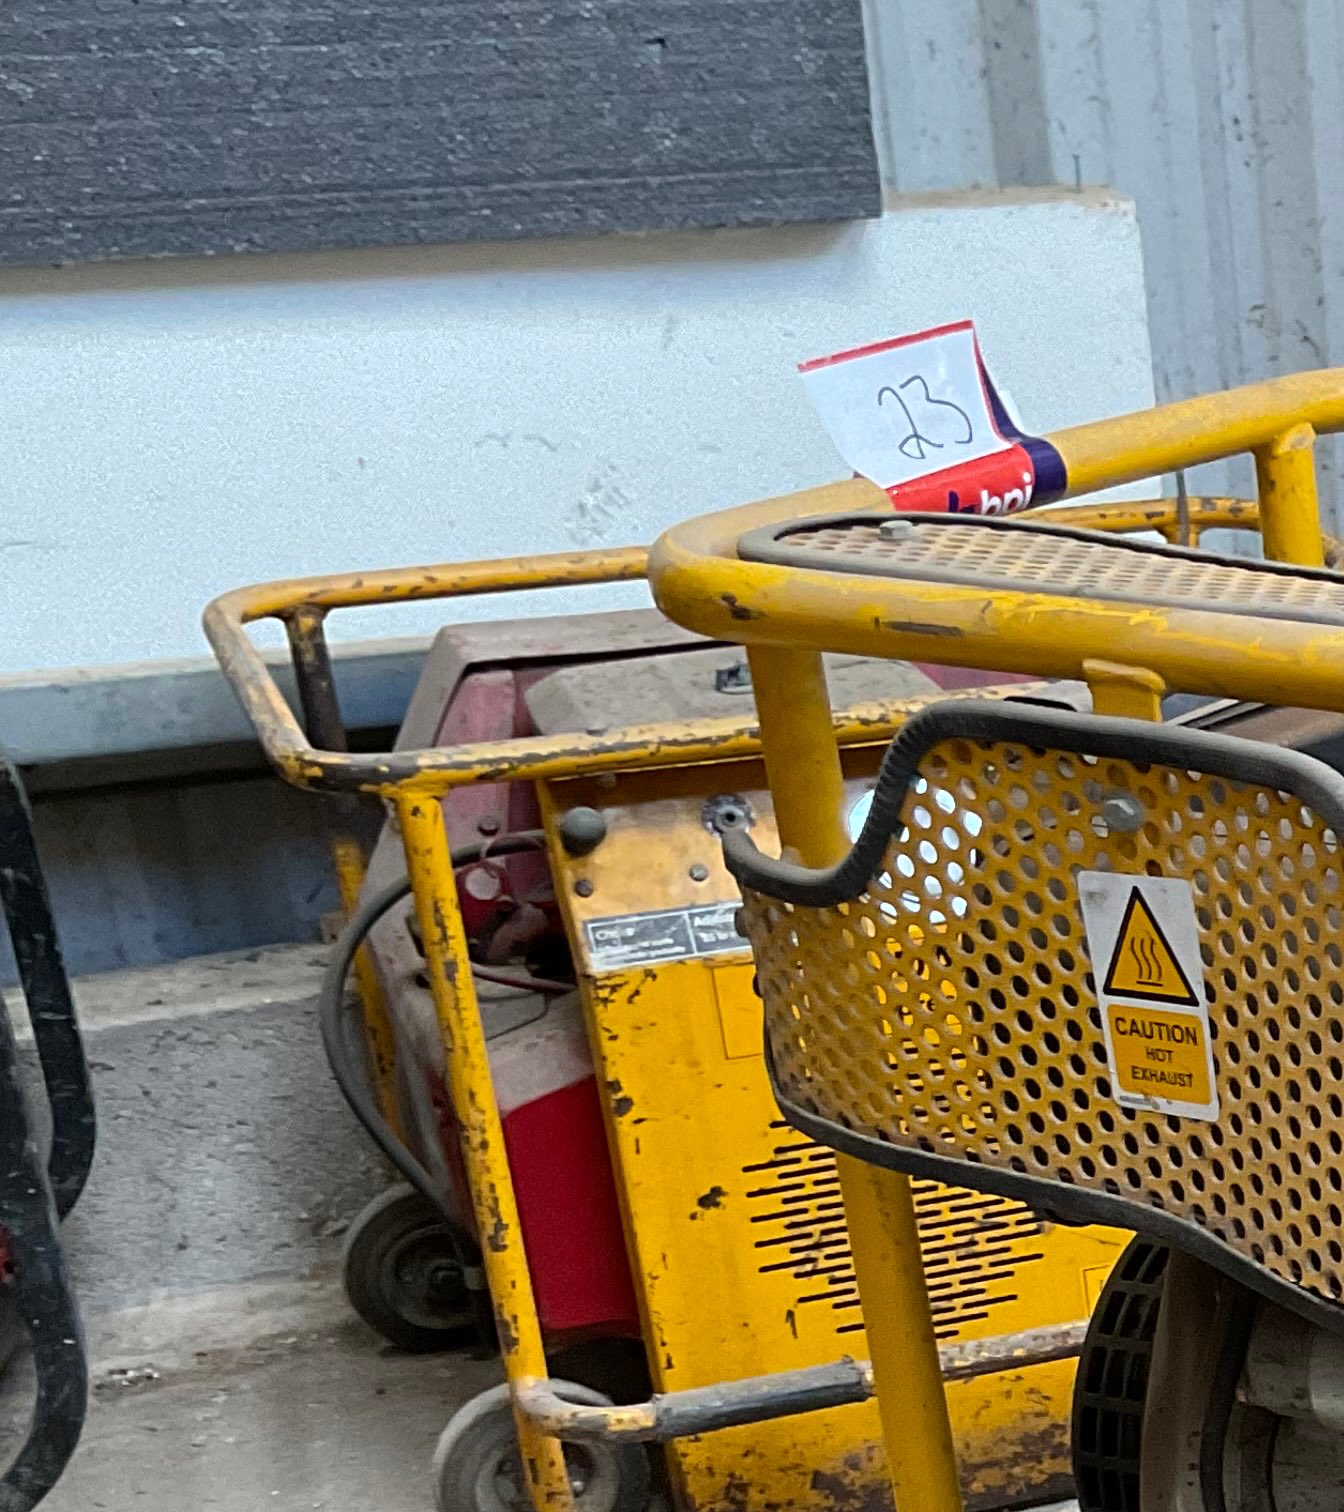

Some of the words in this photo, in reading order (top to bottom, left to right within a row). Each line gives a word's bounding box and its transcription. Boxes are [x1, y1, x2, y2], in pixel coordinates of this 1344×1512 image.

[878, 375, 973, 459] 23
[1114, 1016, 1199, 1047] CAUTION
[1145, 1047, 1174, 1063] HOT
[1131, 1065, 1193, 1088] EXHAUST
